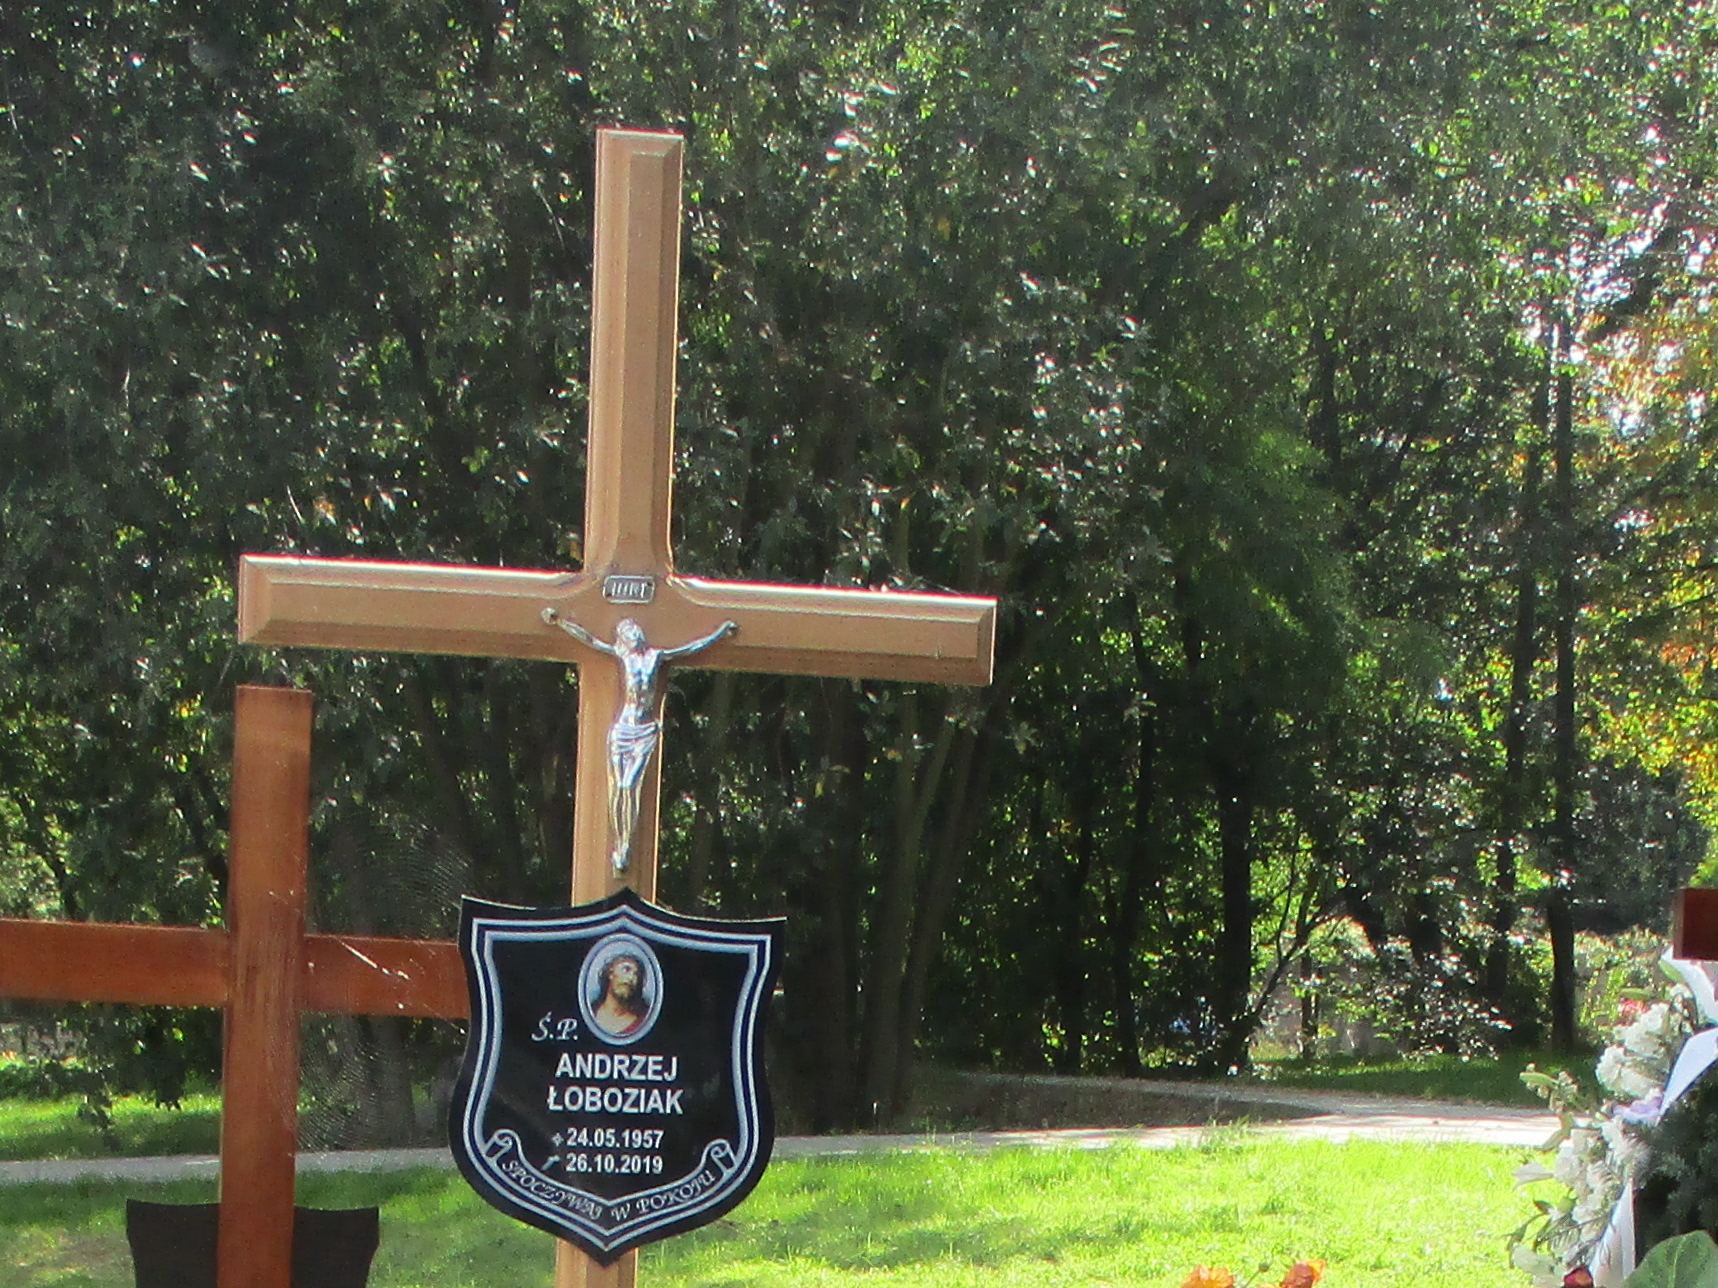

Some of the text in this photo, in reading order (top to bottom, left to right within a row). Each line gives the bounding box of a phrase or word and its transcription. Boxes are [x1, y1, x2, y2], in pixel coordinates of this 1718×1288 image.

[531, 1012, 579, 1041] Ś.P.
[555, 1053, 678, 1081] ANDRZEJ
[547, 1085, 684, 1115] ŁOBOZIAK
[566, 1127, 664, 1149] 24.05.1957
[565, 1152, 664, 1174] 26.10.2019
[502, 1160, 716, 1222] SPOCZYWAJ W POKOJU
